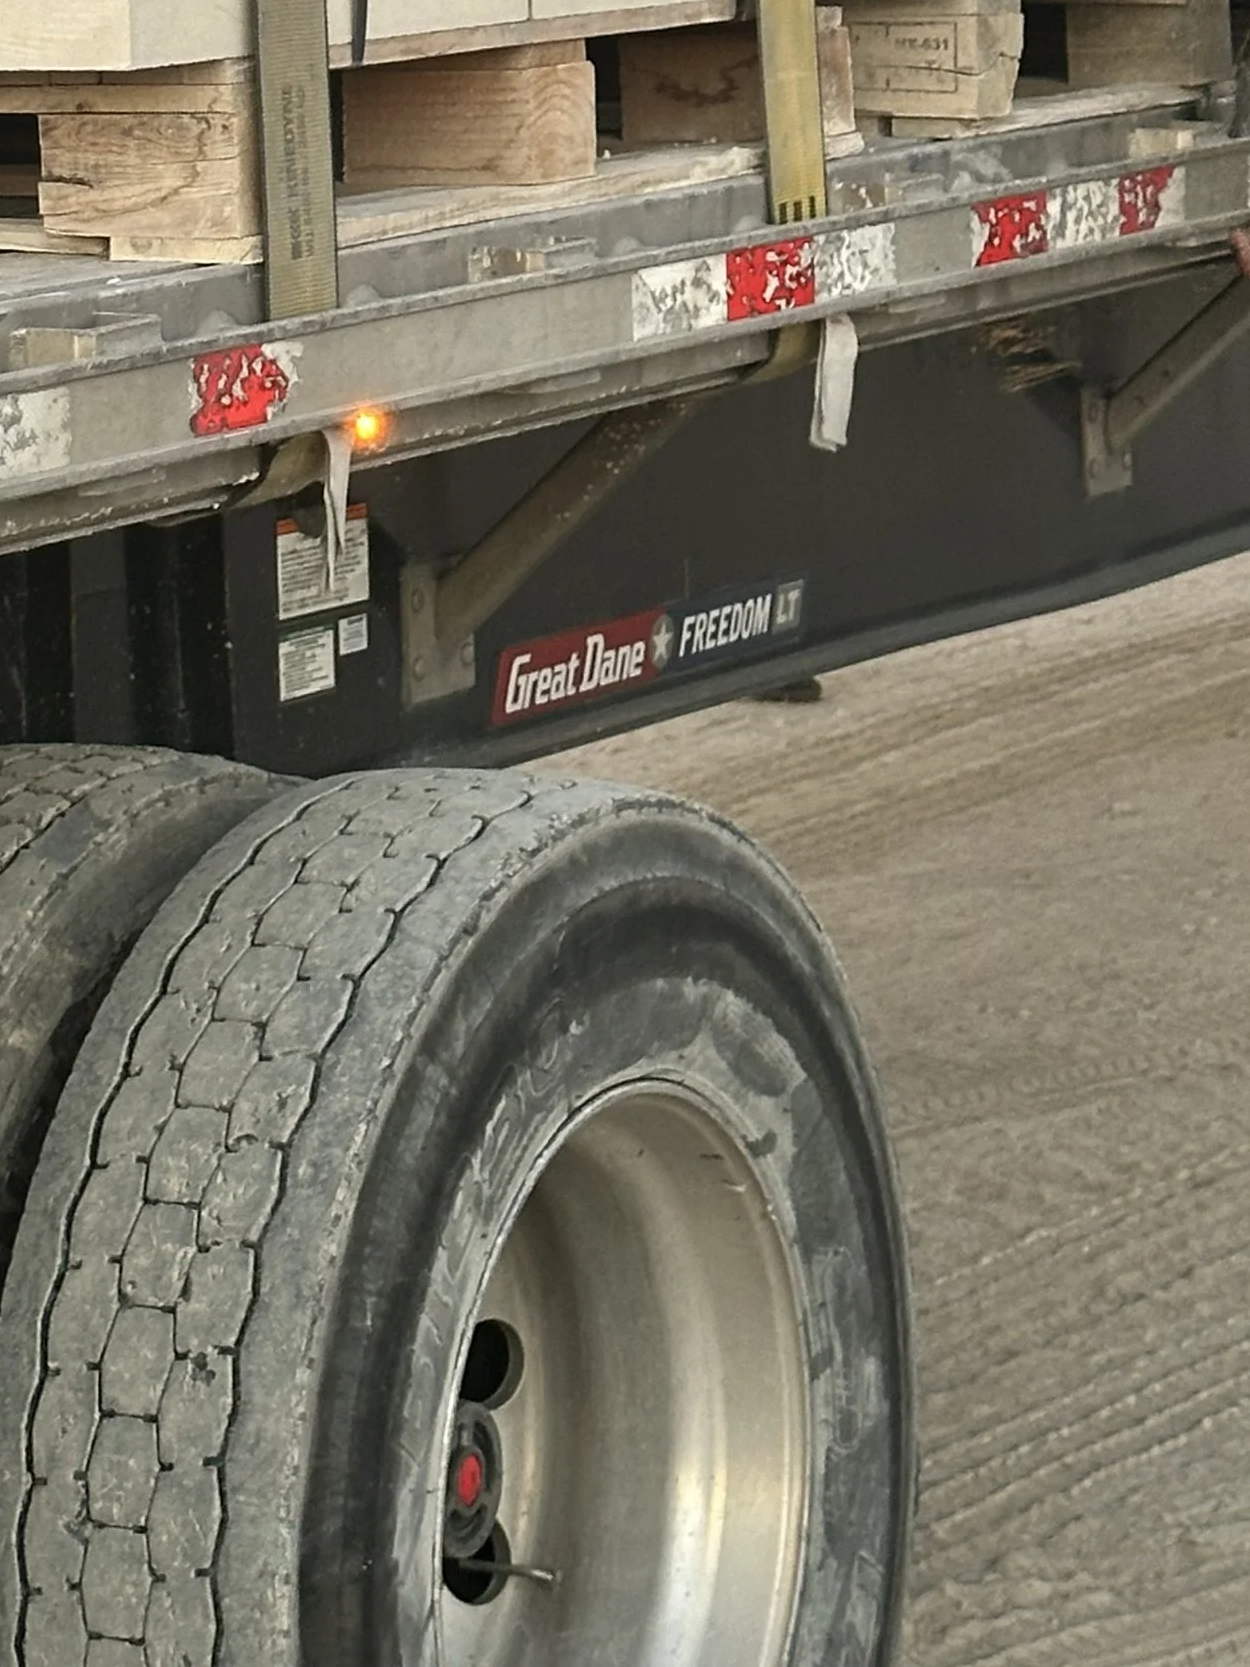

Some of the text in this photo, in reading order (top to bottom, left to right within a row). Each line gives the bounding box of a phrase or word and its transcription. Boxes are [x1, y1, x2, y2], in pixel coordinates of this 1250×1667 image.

[504, 587, 801, 715] Great Dane FREEDOM LT
